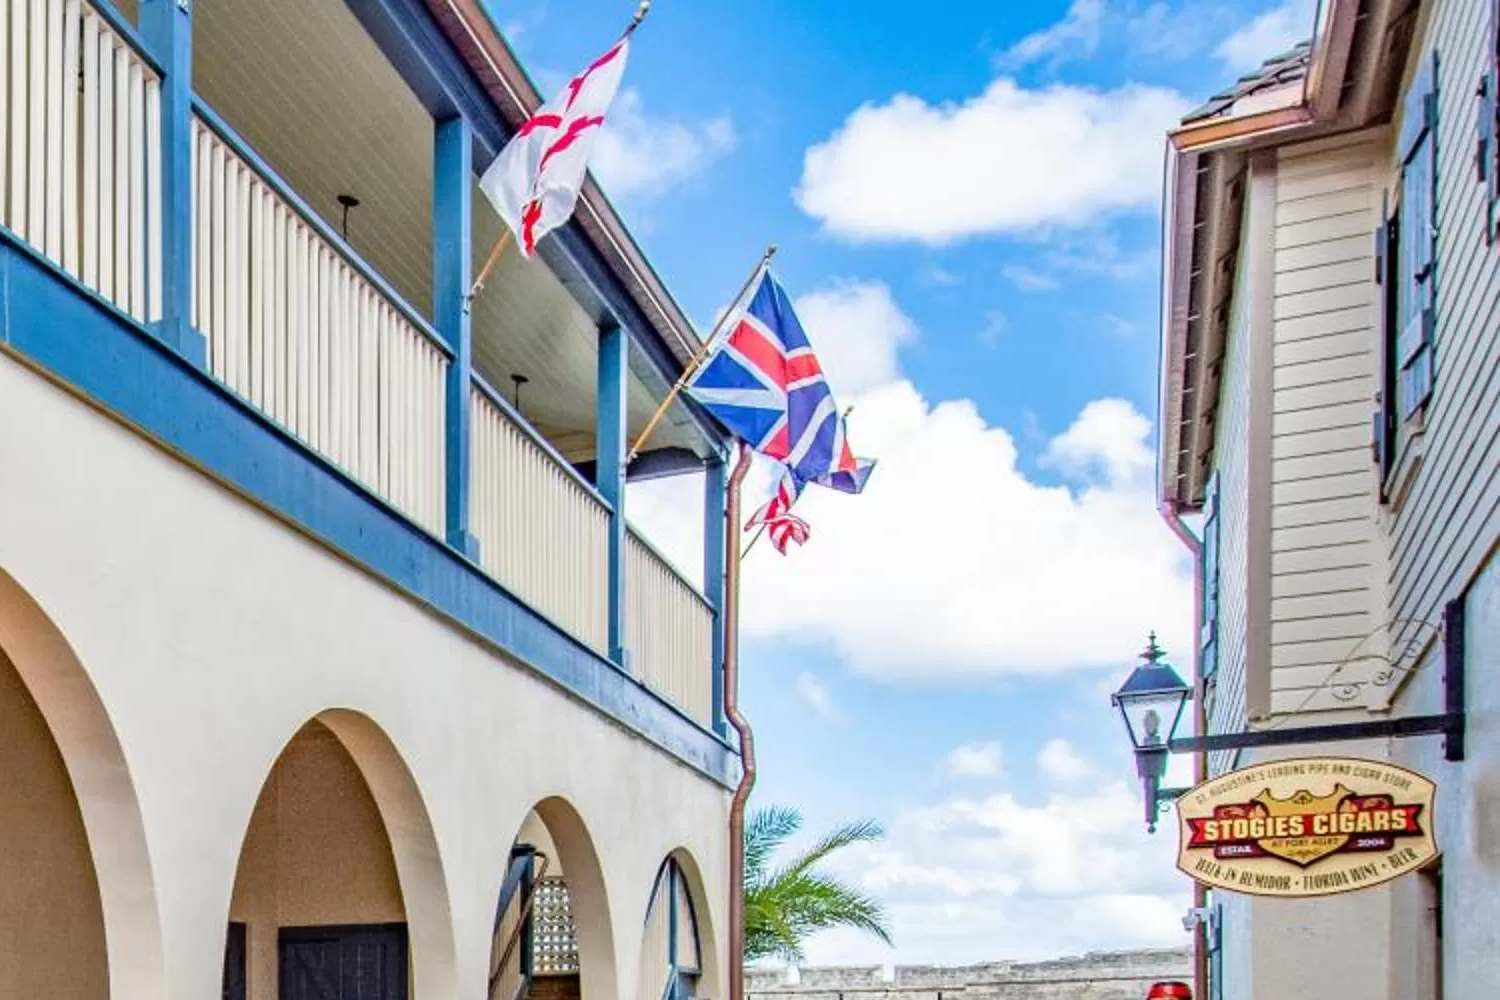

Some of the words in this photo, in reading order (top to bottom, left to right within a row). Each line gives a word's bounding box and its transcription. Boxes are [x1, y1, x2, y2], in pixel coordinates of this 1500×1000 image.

[1308, 764, 1329, 775] PIPE
[1332, 764, 1351, 776] AND
[1353, 766, 1383, 781] CIGAR
[1384, 773, 1412, 791] STORE
[1204, 814, 1304, 841] STOGIES
[1313, 809, 1408, 836] CIGARS
[1195, 857, 1237, 881] WALK-IN
[1239, 870, 1291, 891] HUMIDOR
[1303, 869, 1349, 891] FLORIDA
[1349, 862, 1379, 883] WINE
[1387, 847, 1419, 869] BEER
